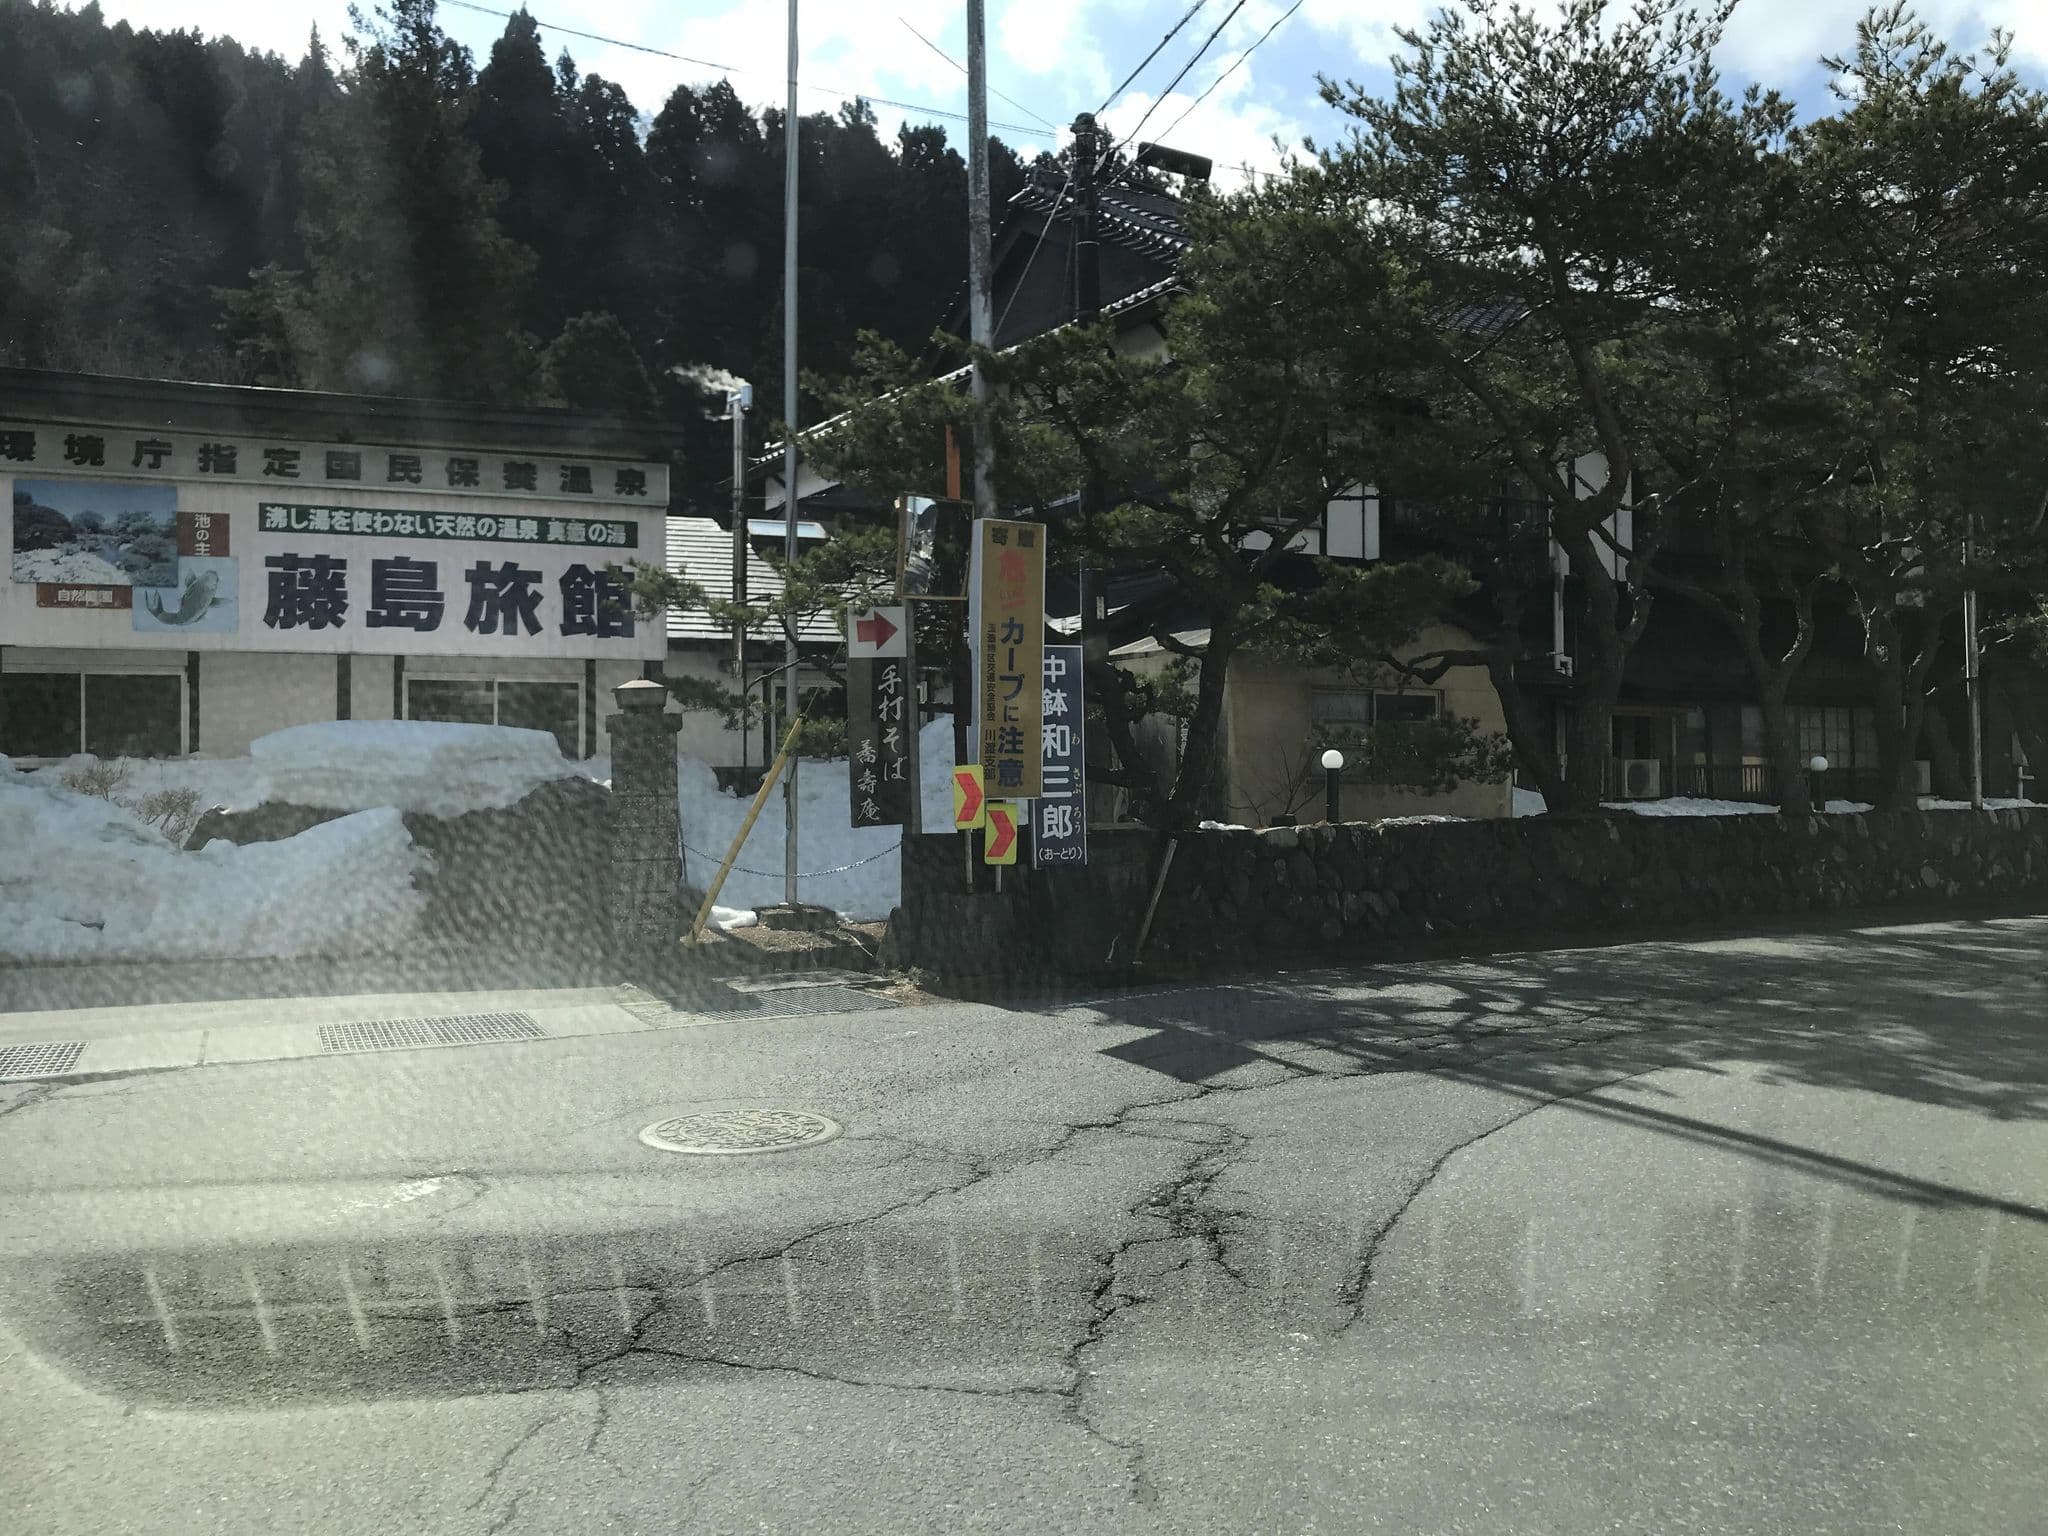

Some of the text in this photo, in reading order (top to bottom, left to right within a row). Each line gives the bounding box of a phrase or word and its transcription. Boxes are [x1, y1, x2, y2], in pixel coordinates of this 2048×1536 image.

[194, 513, 211, 556] 池の主
[263, 552, 635, 639] 藤島旅館
[878, 664, 907, 782] 手打そば
